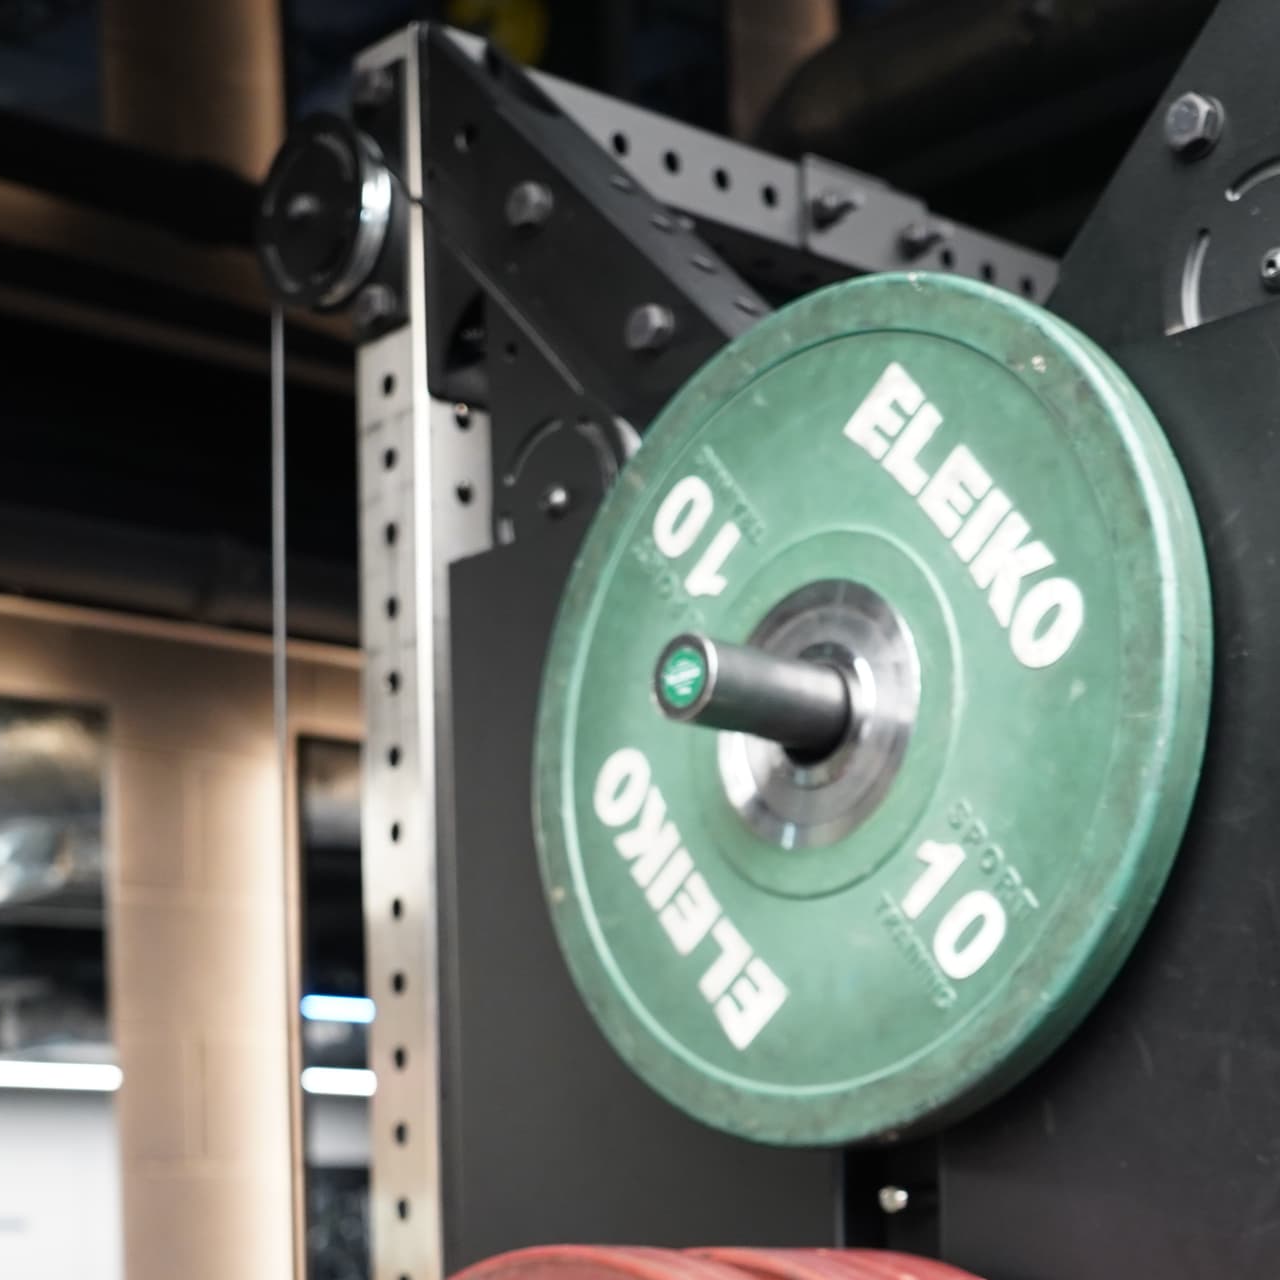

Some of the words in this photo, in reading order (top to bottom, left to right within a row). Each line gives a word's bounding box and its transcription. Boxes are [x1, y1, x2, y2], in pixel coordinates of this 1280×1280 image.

[653, 476, 742, 597] 10
[843, 362, 1084, 668] ELEIKO
[594, 747, 789, 1050] ELEIKO
[901, 838, 1007, 979] 10
